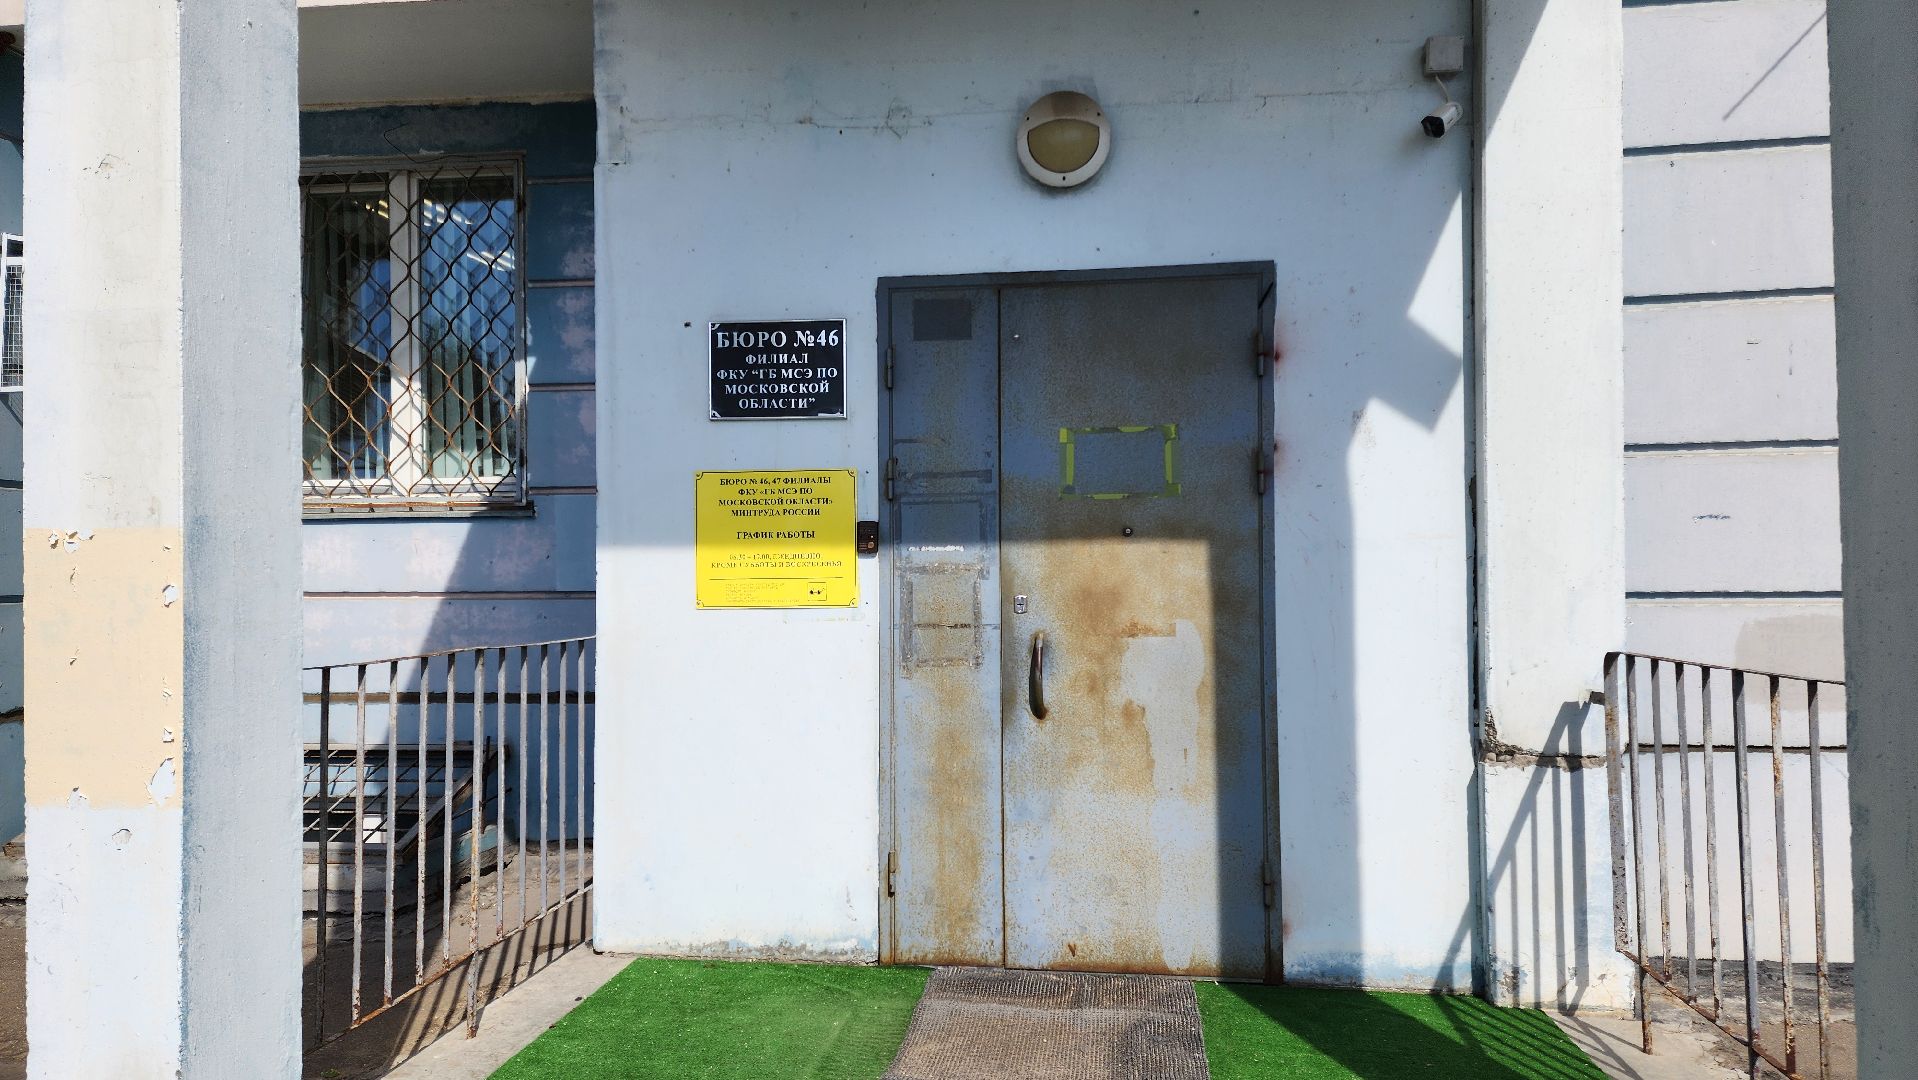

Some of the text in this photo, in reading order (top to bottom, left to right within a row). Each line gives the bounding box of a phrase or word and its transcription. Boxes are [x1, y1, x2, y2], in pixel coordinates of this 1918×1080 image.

[716, 331, 787, 348] БЮРО
[745, 353, 809, 365] ФИЛИАЛ
[716, 369, 748, 380] ФКУ
[781, 368, 813, 379] МСЭ
[817, 367, 838, 378] ПО
[725, 380, 830, 395] МОСКОВСКОЙ
[720, 478, 747, 486] БЮРО
[782, 476, 831, 485] ФИЛИАЛЫ
[738, 488, 758, 496] ФКУ
[799, 487, 813, 495] ПО
[718, 497, 784, 507] МОСКОВСКОЙ
[731, 508, 821, 517] МИНТРУДА РОССИИ
[736, 530, 816, 540] ГРАФИК РАБОТЫ
